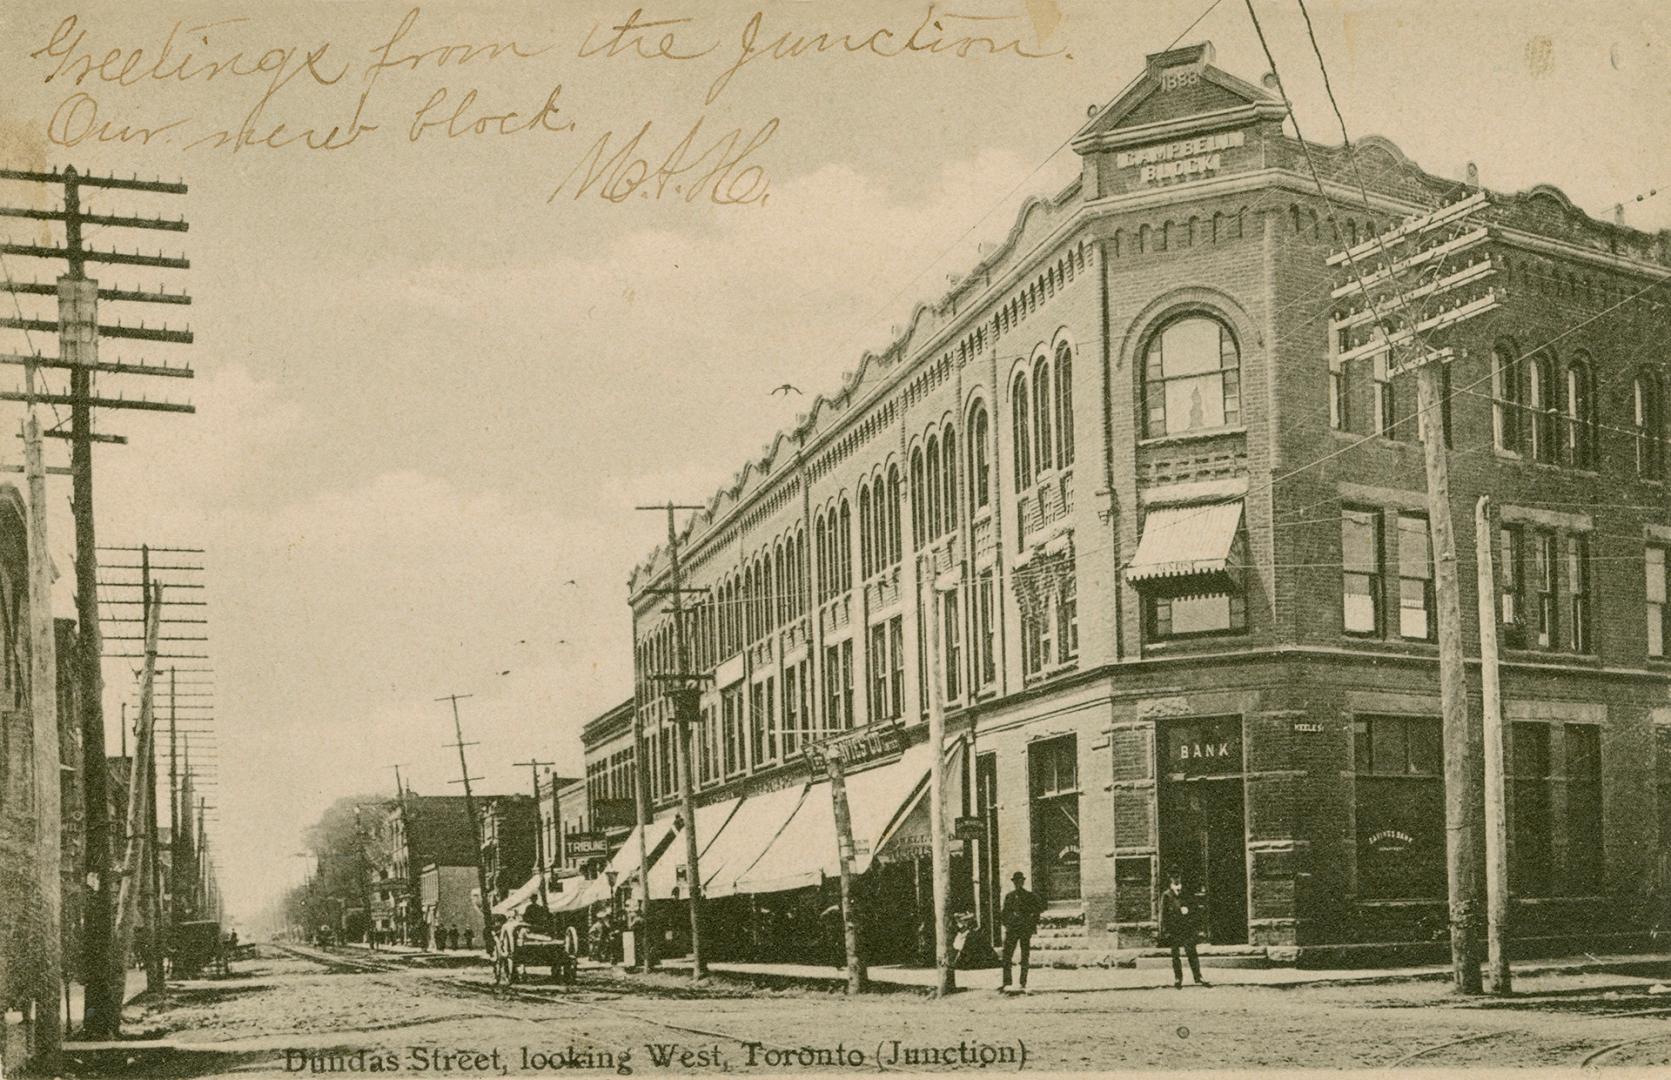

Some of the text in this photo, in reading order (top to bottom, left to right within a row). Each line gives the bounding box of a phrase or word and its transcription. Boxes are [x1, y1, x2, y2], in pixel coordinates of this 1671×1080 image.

[352, 7, 550, 100] from
[578, 8, 719, 60] the
[1161, 71, 1200, 92] 1888
[1116, 131, 1245, 168] CAMPBELL
[1140, 153, 1220, 184] BLOCK
[1180, 742, 1229, 759] BANK
[567, 840, 608, 853] TRIBUNE
